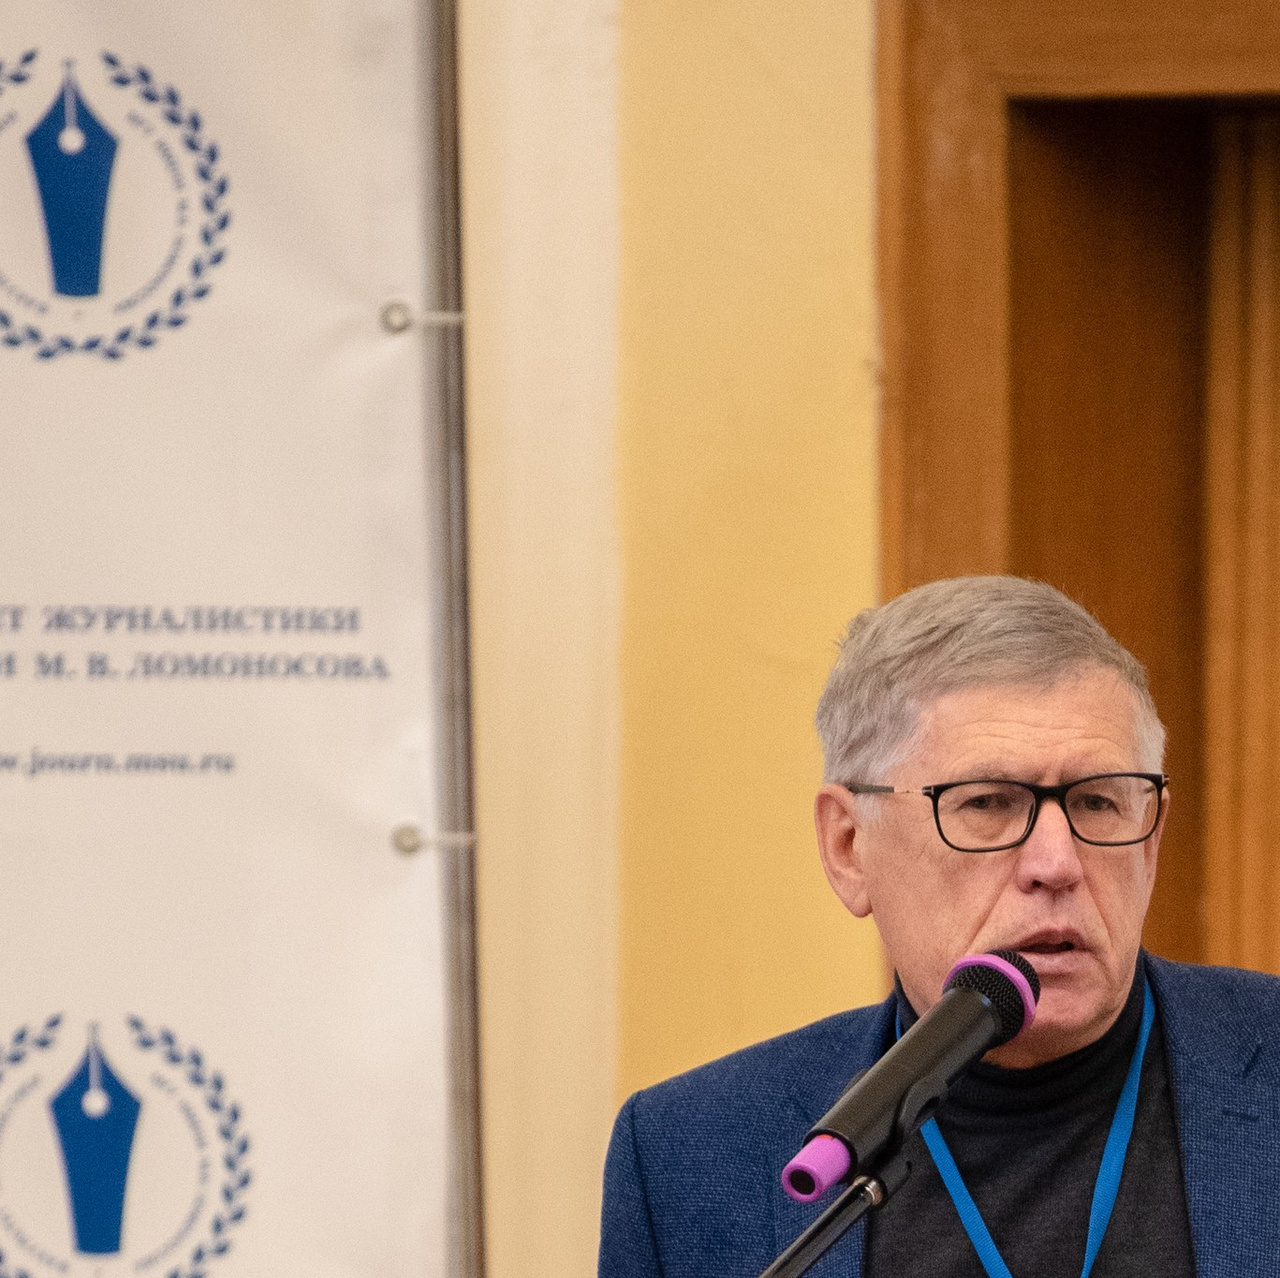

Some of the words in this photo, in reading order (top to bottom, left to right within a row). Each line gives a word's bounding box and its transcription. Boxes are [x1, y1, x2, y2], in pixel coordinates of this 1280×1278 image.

[42, 605, 362, 634] ЖУРНАЛИСТИКИ
[35, 651, 78, 680] М.
[87, 651, 120, 680] В.
[128, 651, 391, 680] ЛОМОНОСОВА
